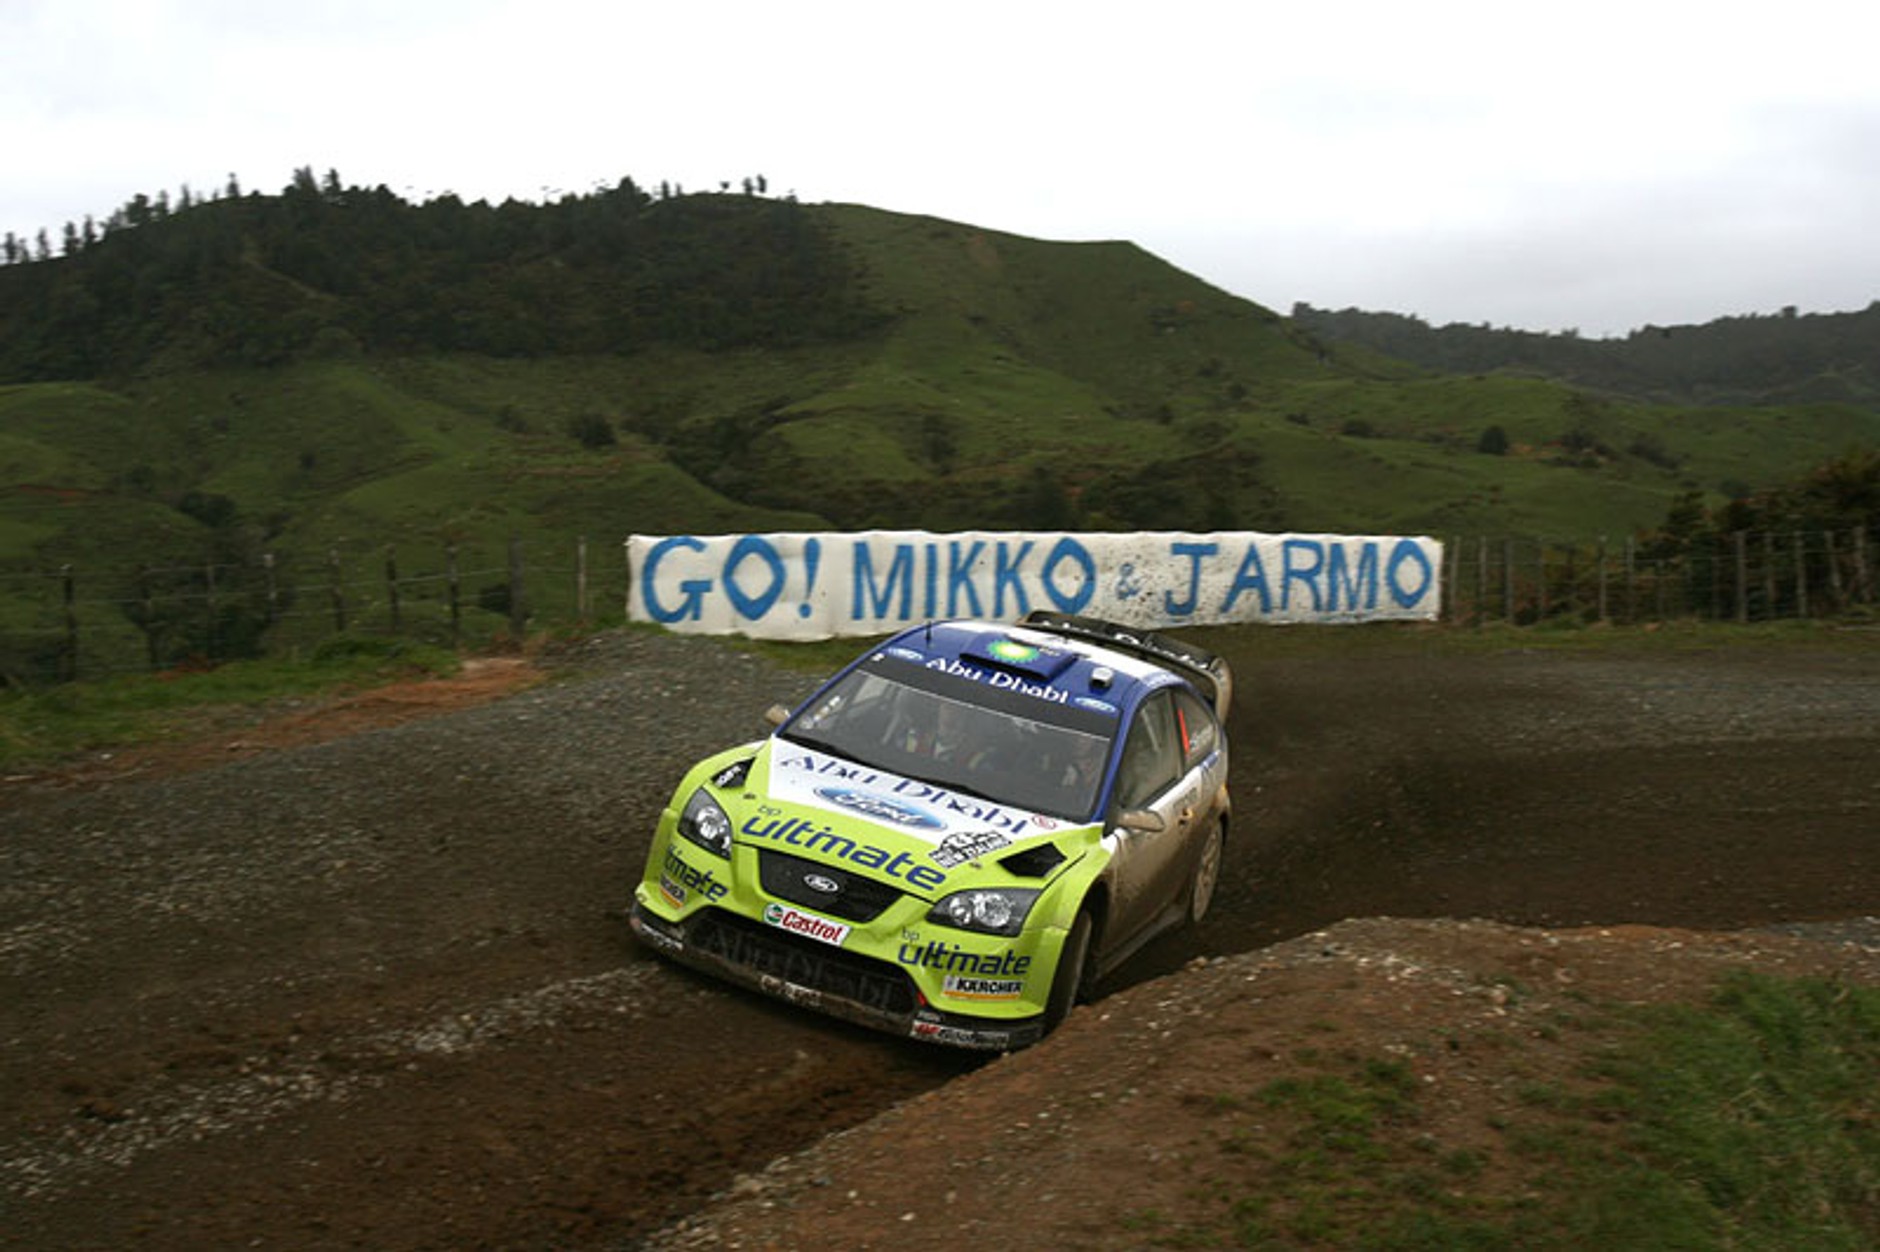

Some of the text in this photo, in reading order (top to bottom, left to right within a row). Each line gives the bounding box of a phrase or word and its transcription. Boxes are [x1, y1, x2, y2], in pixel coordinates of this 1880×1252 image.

[641, 534, 1432, 623] GO! MIKKO & JARMO
[926, 658, 1070, 704] Abu Dhabi
[780, 756, 878, 784] Abu
[892, 779, 1028, 835] Dhabi
[741, 816, 946, 891] ultimate
[781, 910, 844, 943] Castrol
[898, 940, 1032, 977] ultimate
